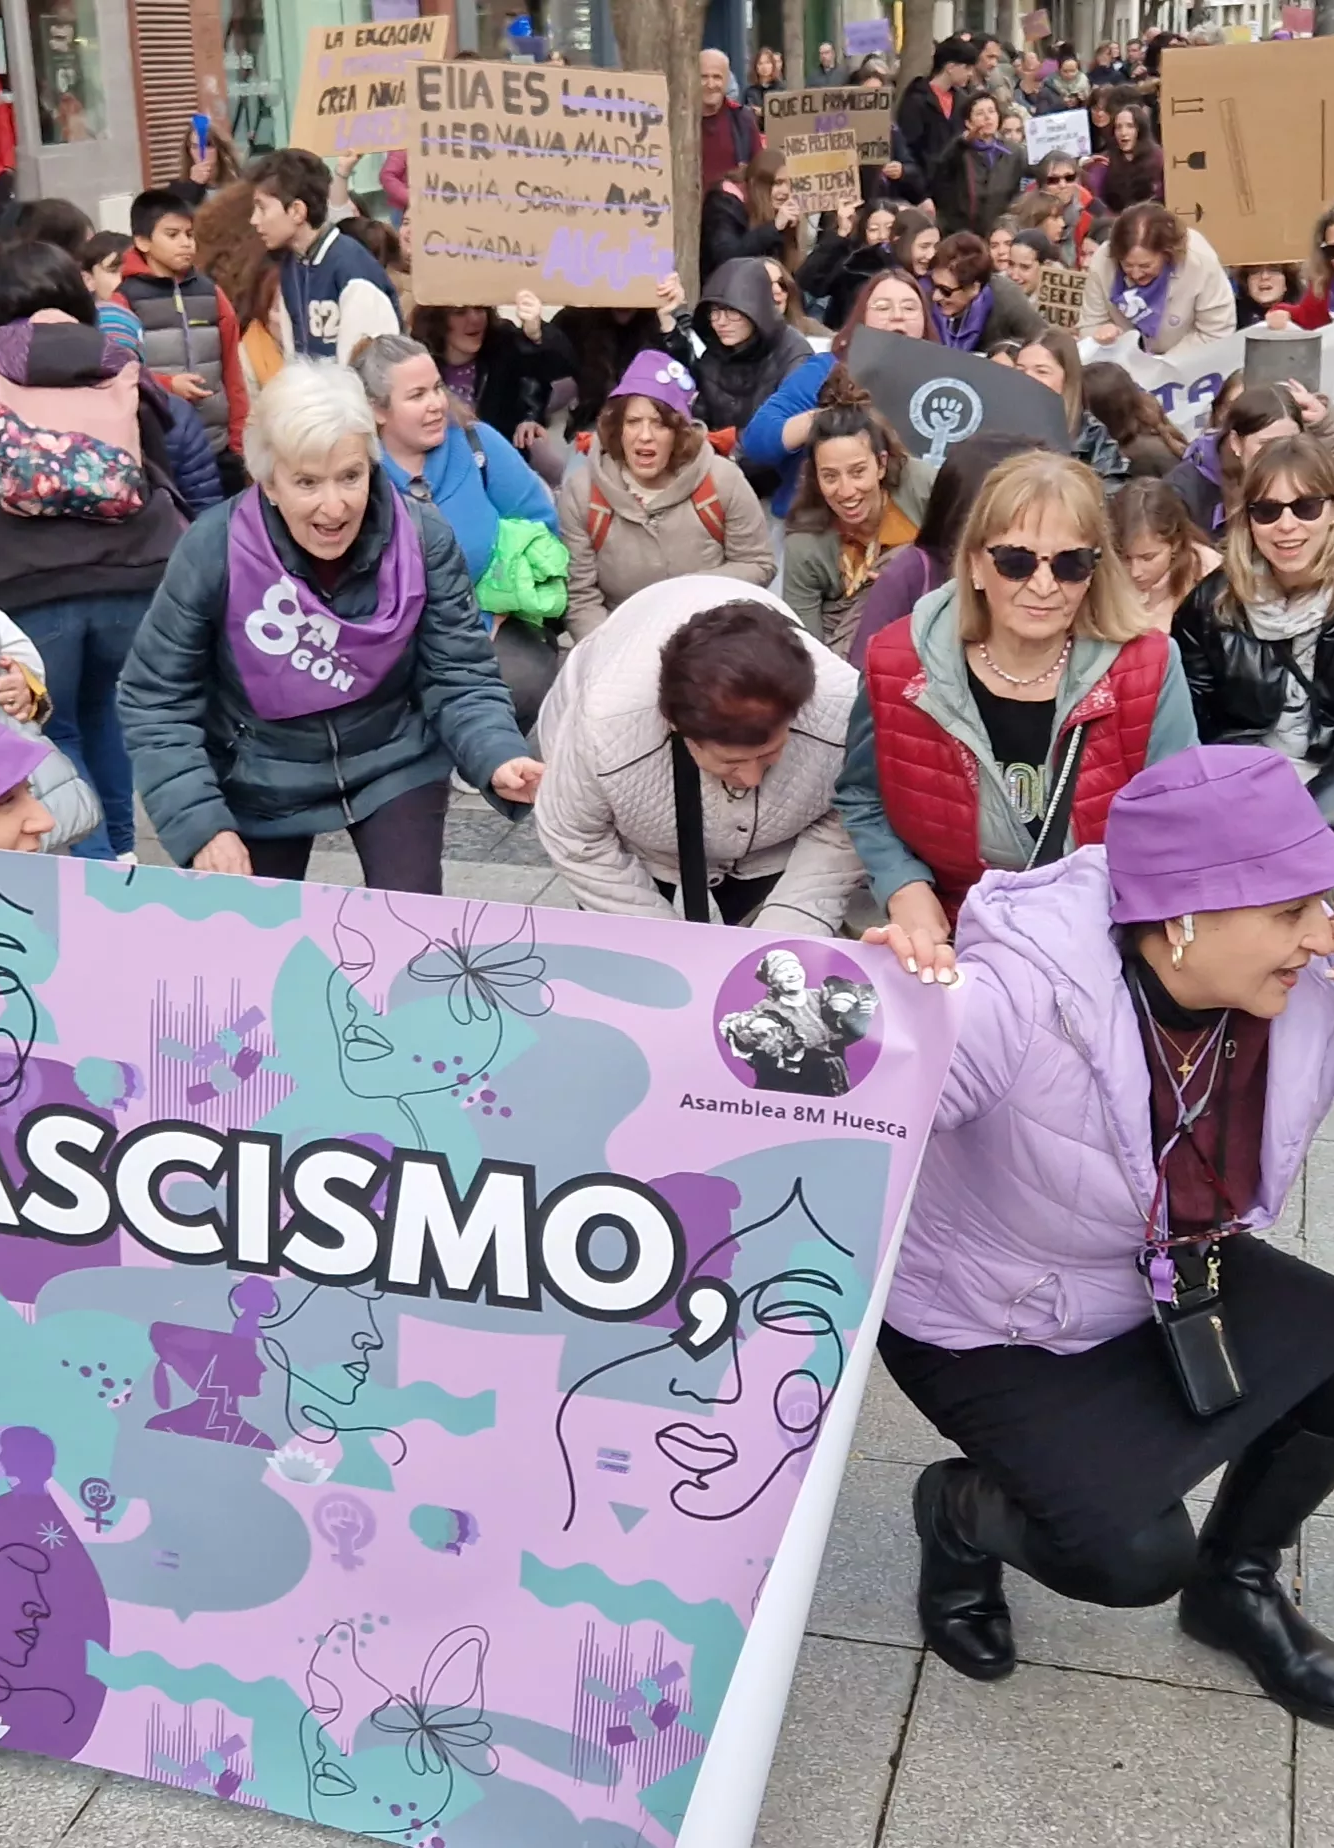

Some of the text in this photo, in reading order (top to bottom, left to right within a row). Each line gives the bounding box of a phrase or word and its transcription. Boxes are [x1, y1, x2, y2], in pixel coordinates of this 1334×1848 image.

[317, 84, 357, 116] CREA
[502, 71, 549, 116] ES
[768, 97, 798, 117] QUE
[802, 94, 819, 114] EL
[1042, 271, 1087, 290] FELIZ
[1038, 285, 1066, 304] SER
[679, 1093, 908, 1139] Asamblea 8M Huesca
